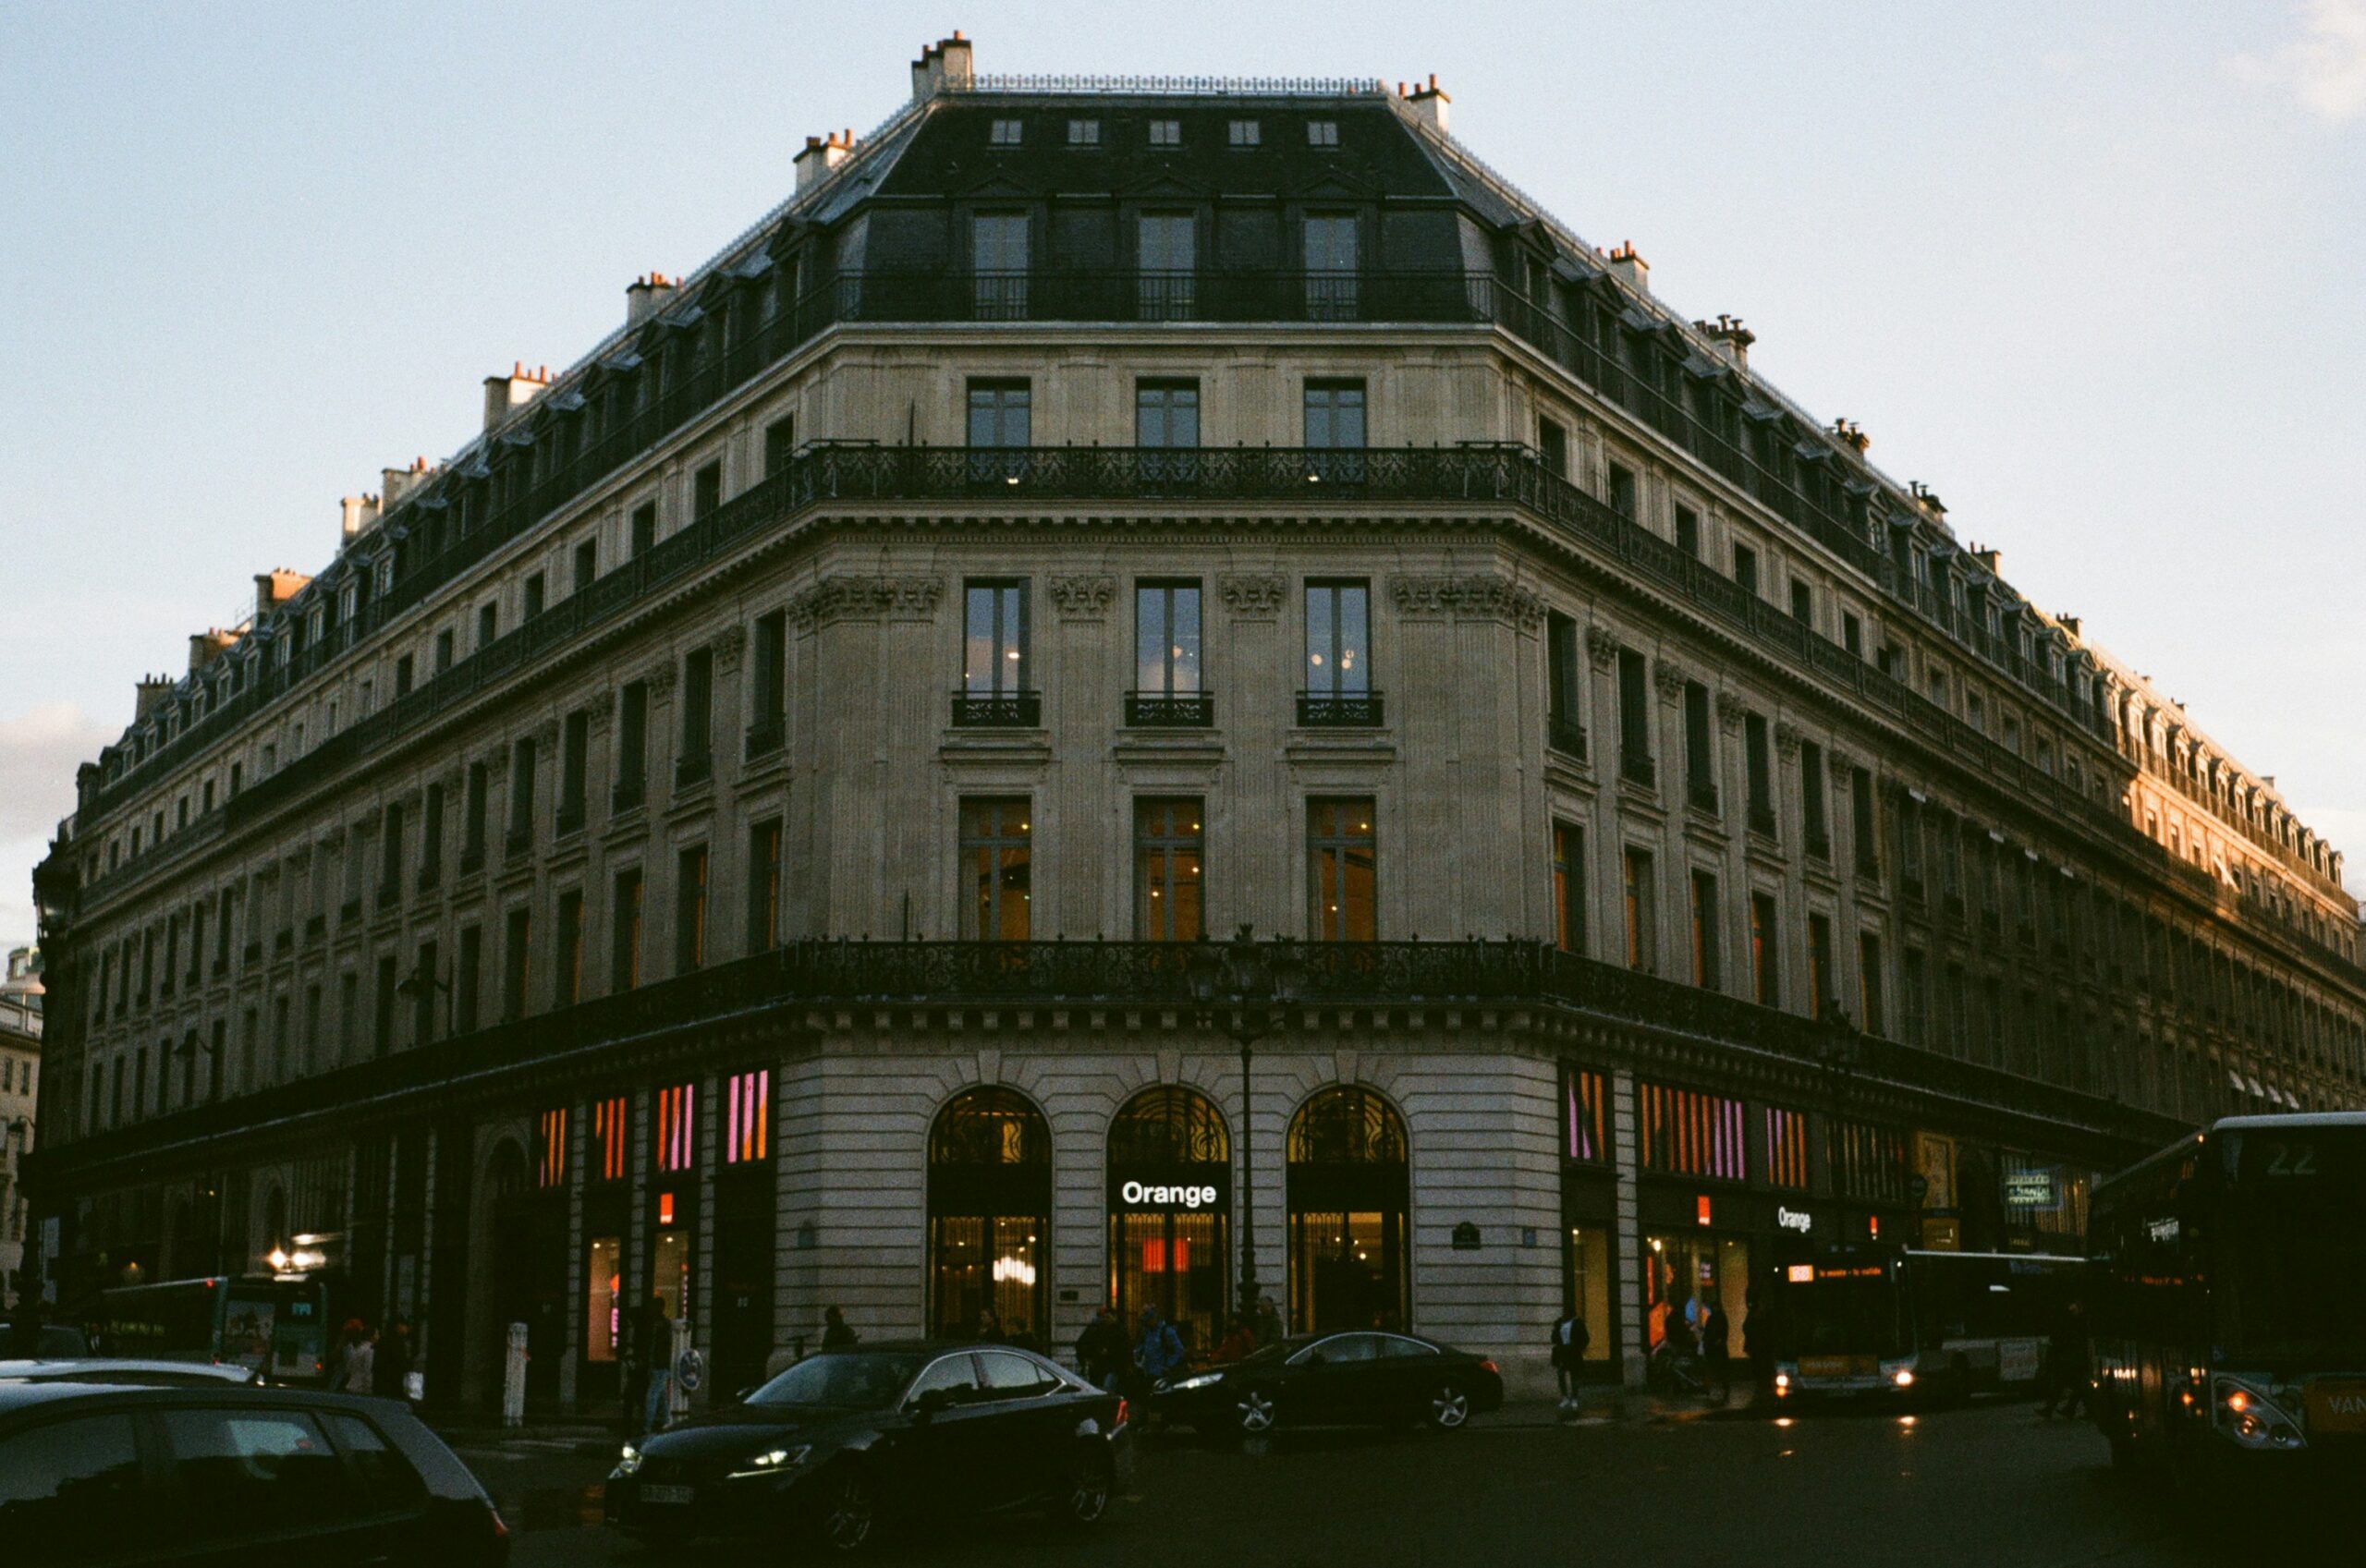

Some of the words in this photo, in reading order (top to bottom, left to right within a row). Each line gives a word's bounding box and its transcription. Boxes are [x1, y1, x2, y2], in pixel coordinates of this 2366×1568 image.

[2266, 1142, 2316, 1174] 22
[1122, 1181, 1216, 1208] Orange
[1778, 1206, 1811, 1233] Orange
